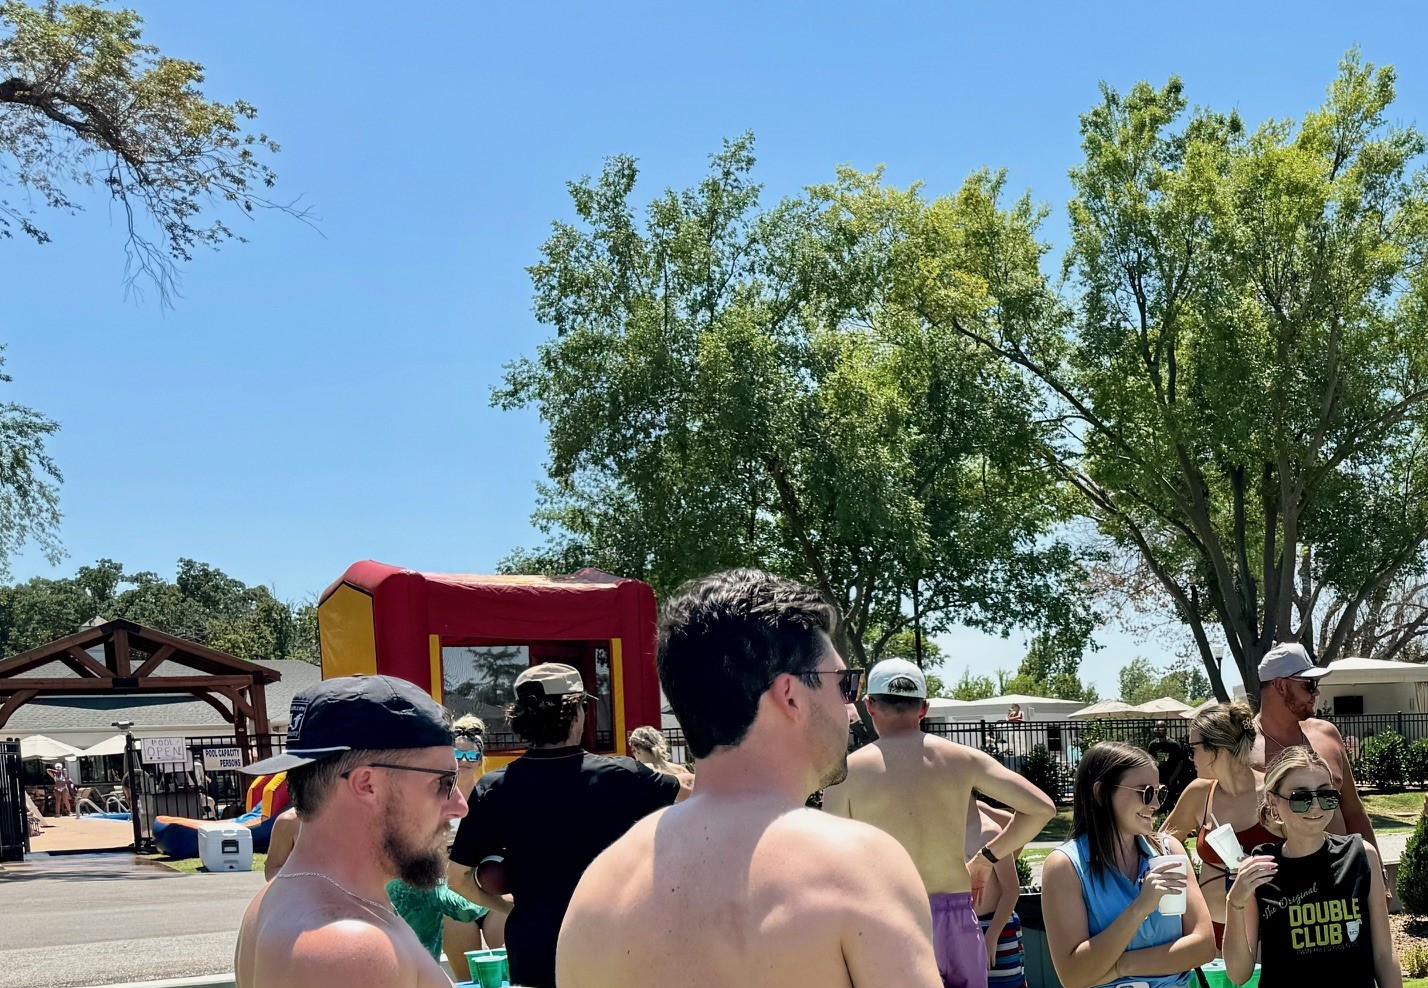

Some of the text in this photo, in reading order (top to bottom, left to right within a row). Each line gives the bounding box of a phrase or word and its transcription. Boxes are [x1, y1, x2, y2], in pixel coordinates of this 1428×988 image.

[147, 746, 183, 757] OPEN
[205, 749, 240, 757] POOL CAPACITY
[220, 759, 241, 767] PERSONS
[1262, 882, 1318, 919] The Original
[1288, 897, 1362, 927] DOUBLE
[1290, 923, 1343, 950] CLUB
